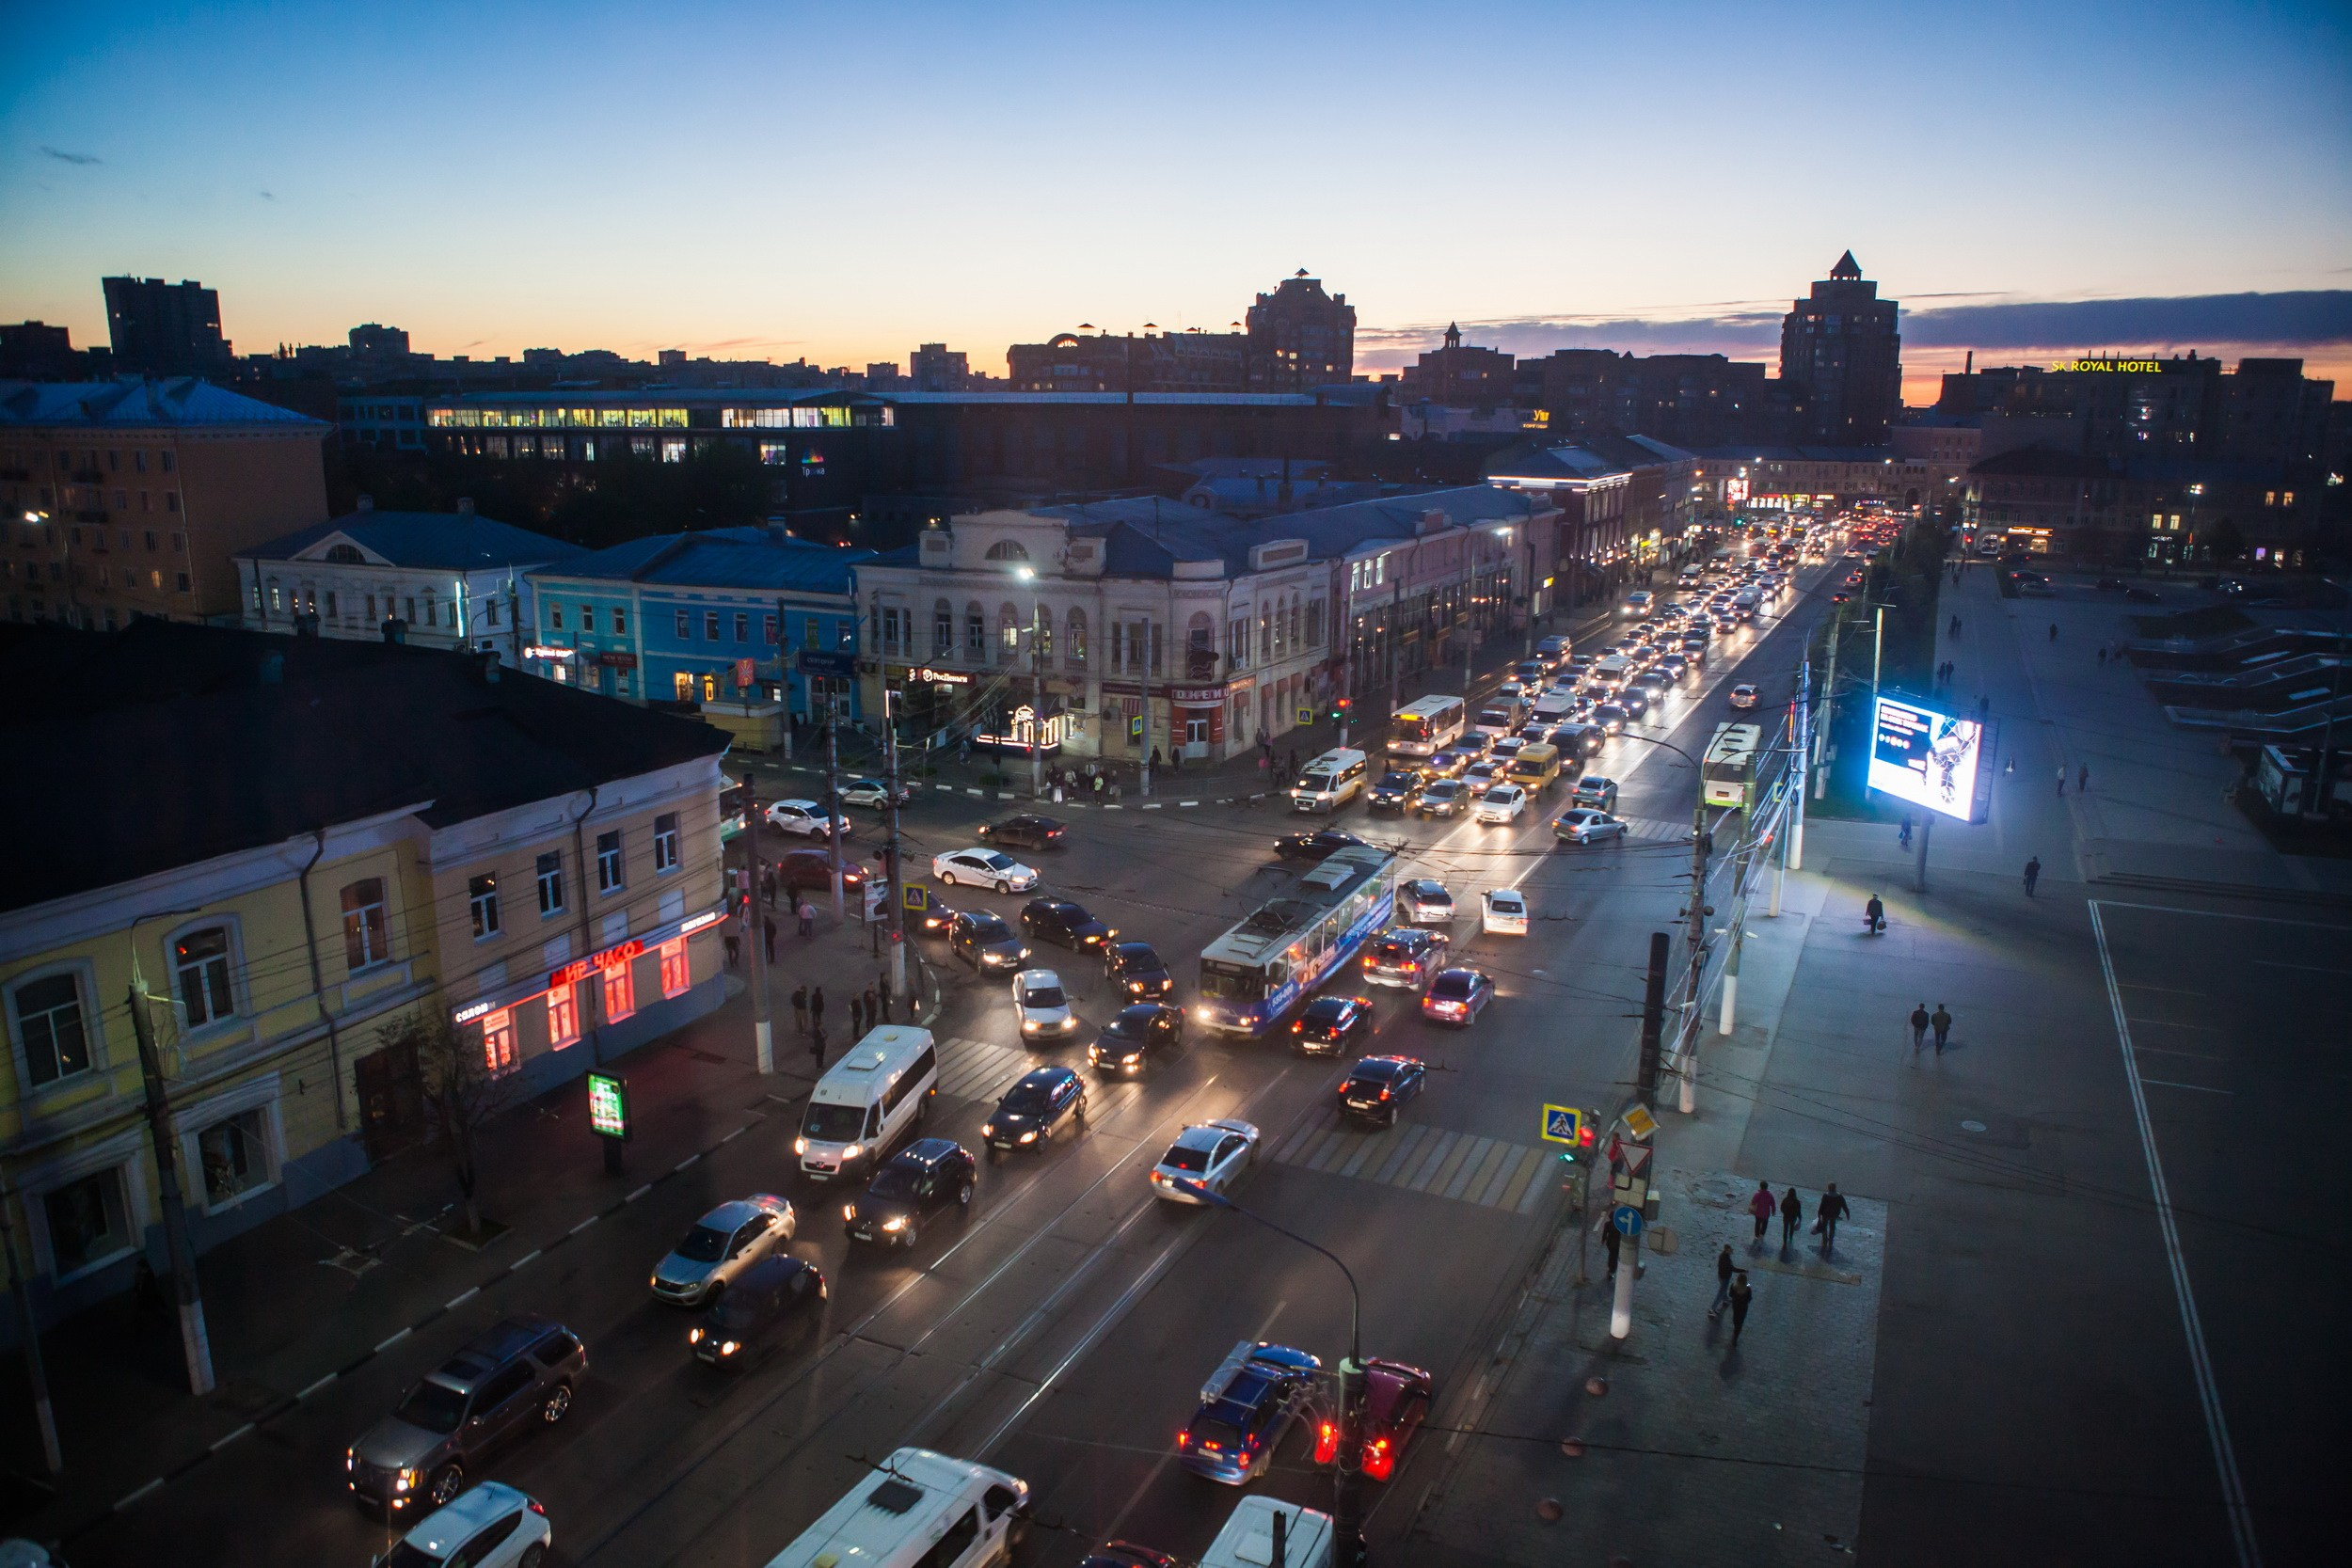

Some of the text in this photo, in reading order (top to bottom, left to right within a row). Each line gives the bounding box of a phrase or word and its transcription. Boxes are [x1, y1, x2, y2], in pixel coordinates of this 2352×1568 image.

[2052, 361, 2162, 372] SK ROYAL HOTEL
[933, 672, 968, 683] РосДеньги
[549, 939, 644, 989] МИР ЧАСОВ
